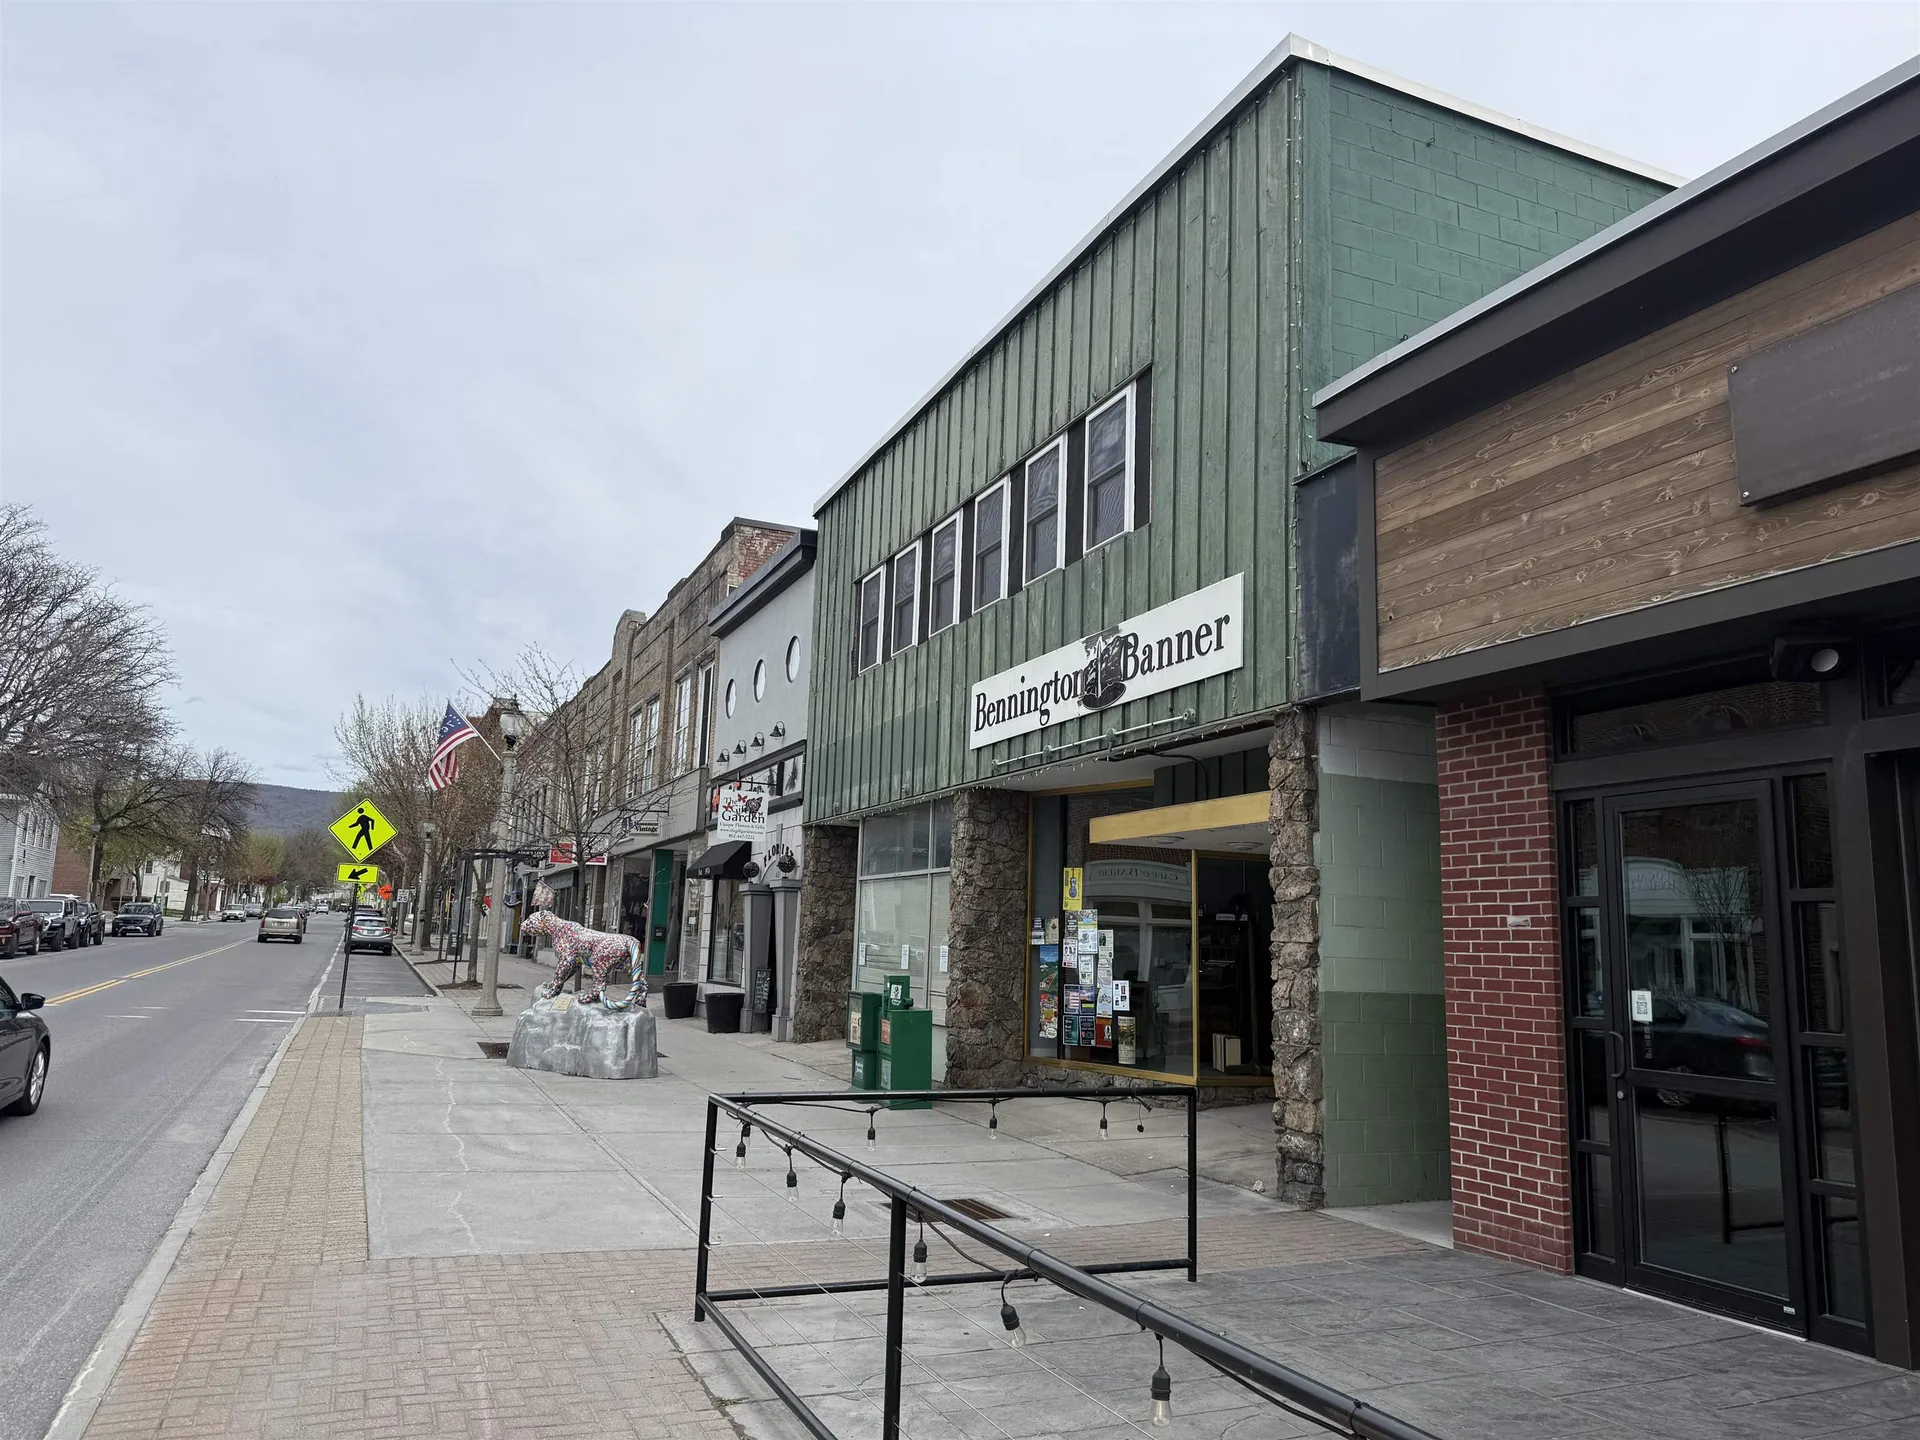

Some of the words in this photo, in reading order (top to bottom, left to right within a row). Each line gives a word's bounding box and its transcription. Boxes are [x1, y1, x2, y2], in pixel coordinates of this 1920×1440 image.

[975, 668, 1085, 732] Bennington
[1121, 613, 1231, 682] Banner
[723, 797, 738, 805] The
[722, 810, 765, 824] Garden
